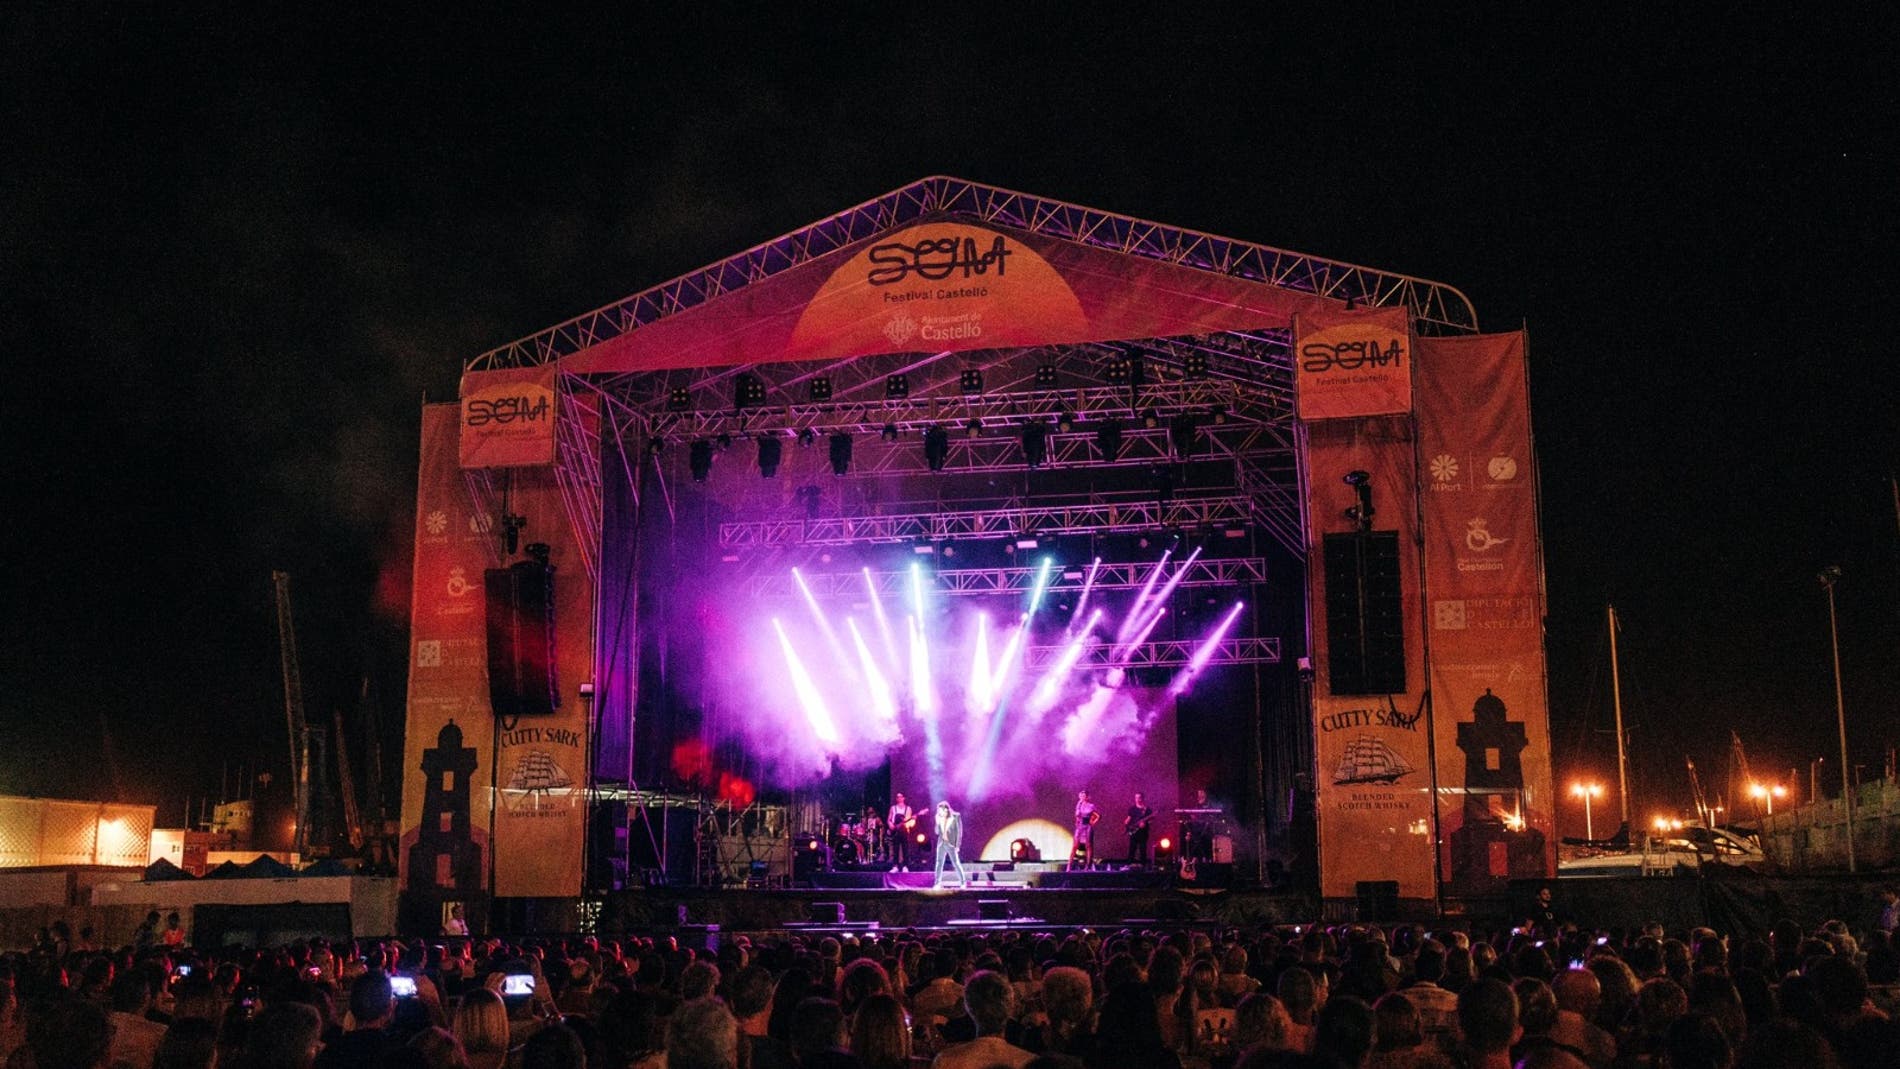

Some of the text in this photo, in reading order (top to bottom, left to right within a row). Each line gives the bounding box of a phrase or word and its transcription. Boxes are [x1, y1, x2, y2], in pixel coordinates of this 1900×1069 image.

[883, 290, 933, 302] Festival
[921, 322, 982, 340] Castelló
[1321, 708, 1417, 732] CUTTY SARK
[501, 727, 582, 748] CUTTY SARK
[1352, 793, 1395, 801] BLENDED
[1338, 802, 1409, 810] SCOTCH WHISKY
